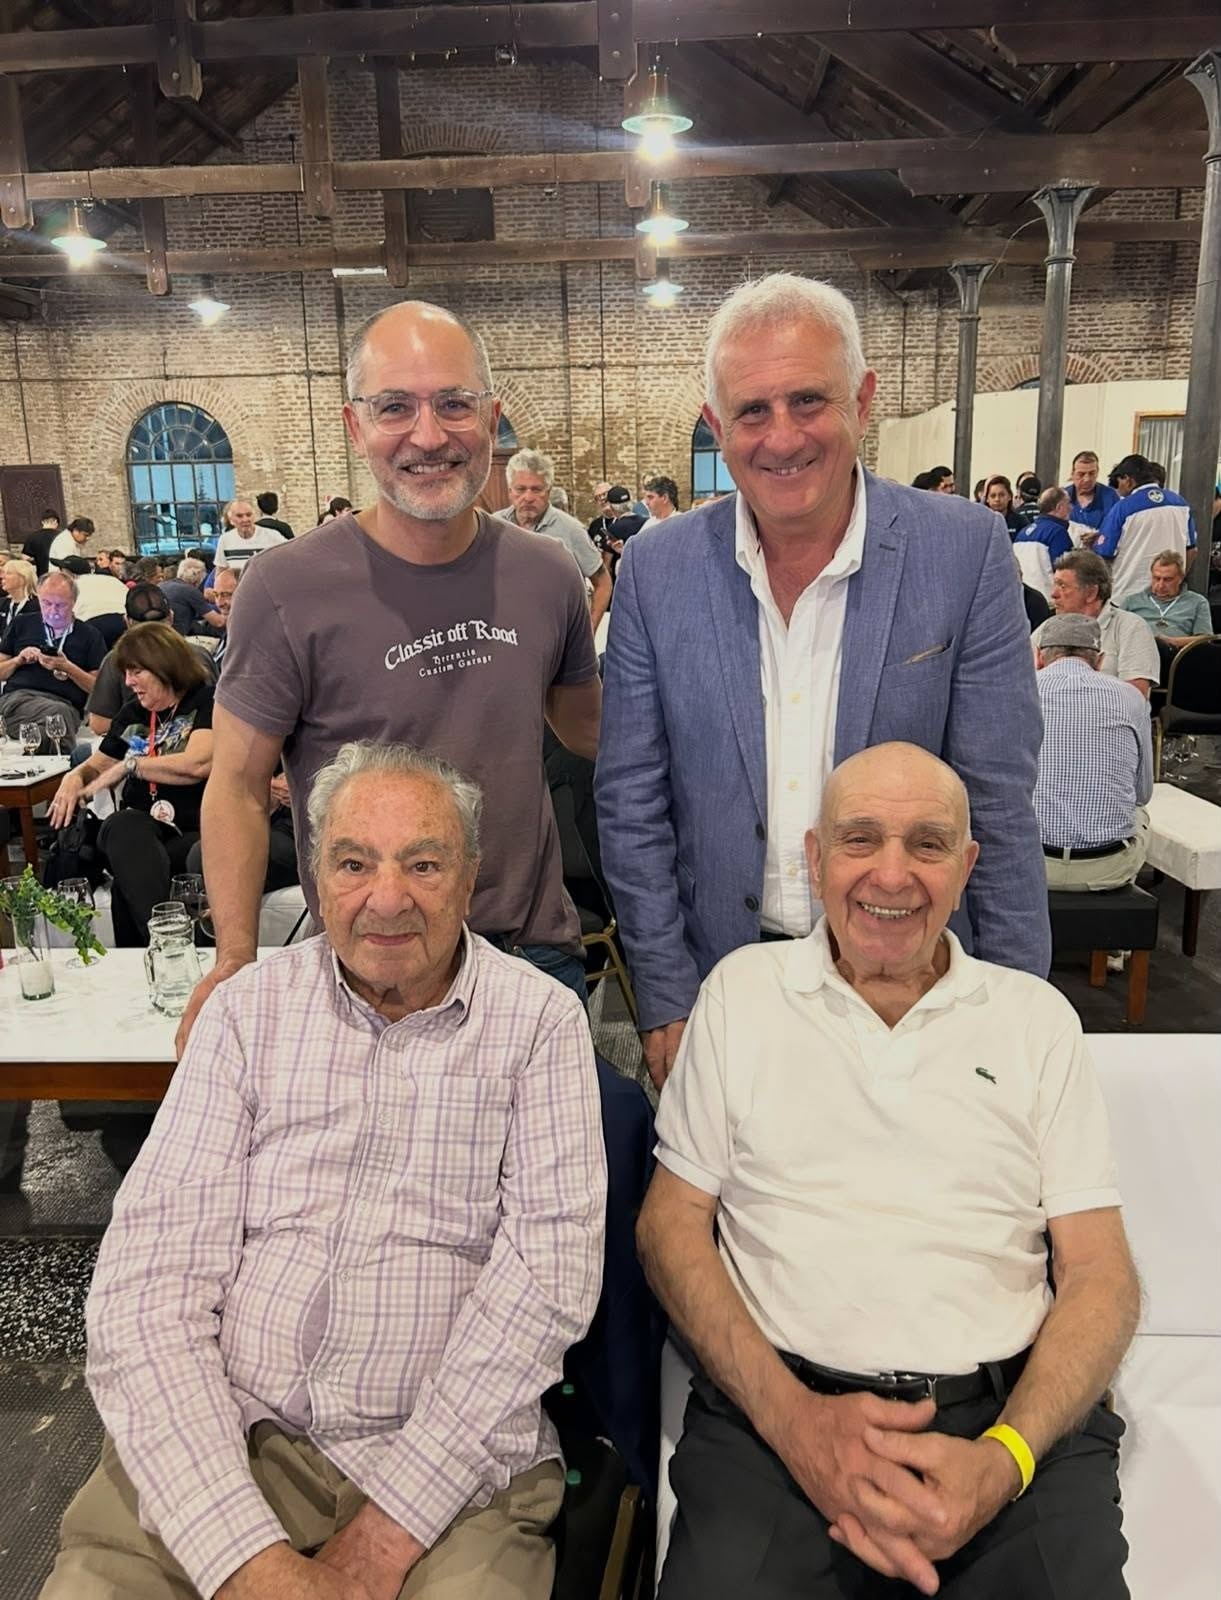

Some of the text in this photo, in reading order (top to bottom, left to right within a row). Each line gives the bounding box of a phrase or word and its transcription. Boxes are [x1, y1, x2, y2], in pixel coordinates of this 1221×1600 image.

[384, 619, 519, 670] Classic off Road
[419, 655, 492, 677] Custom Garage
